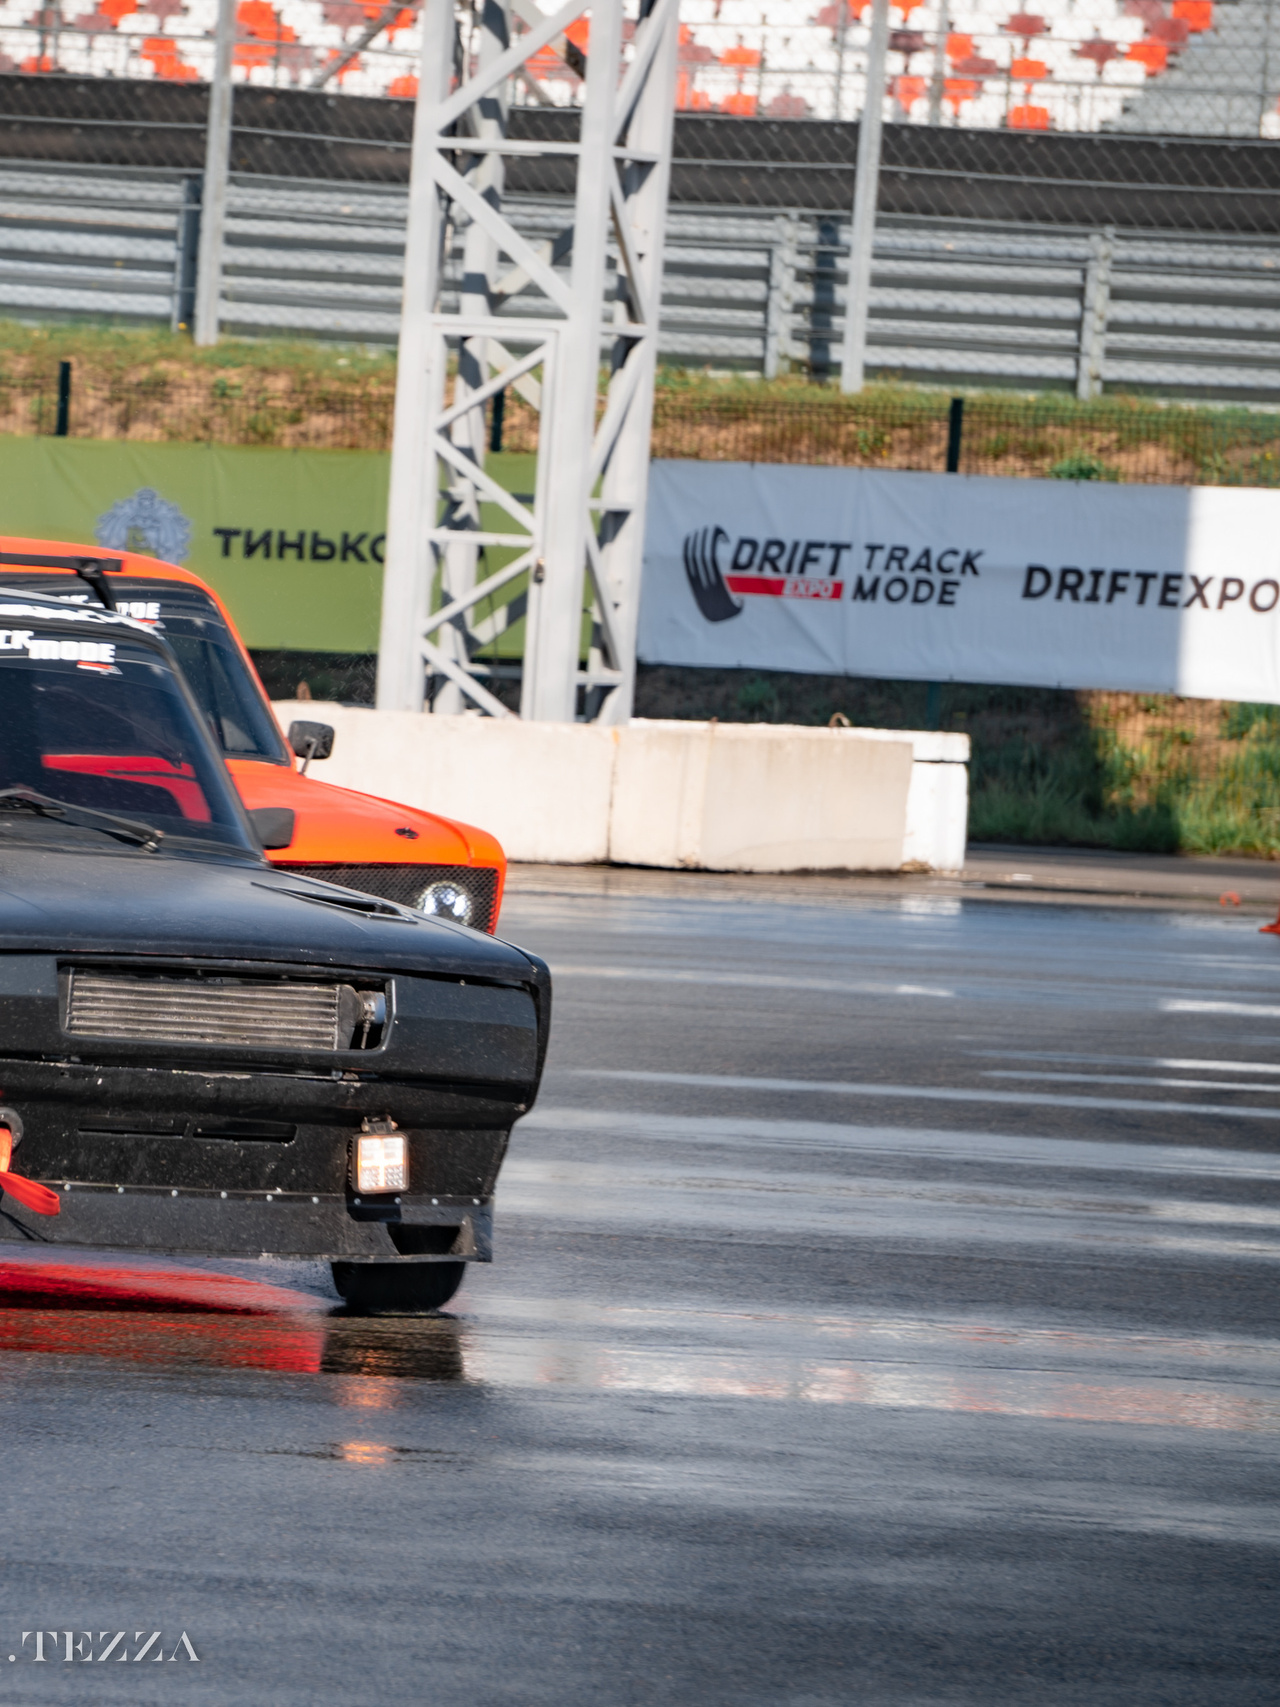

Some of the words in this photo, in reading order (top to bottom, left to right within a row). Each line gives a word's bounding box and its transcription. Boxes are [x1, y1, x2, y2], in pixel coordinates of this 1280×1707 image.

[730, 537, 852, 576] DRIFT
[864, 544, 984, 576] TRACK
[852, 574, 961, 606] MODE
[1022, 564, 1280, 613] DRIFTEXPO
